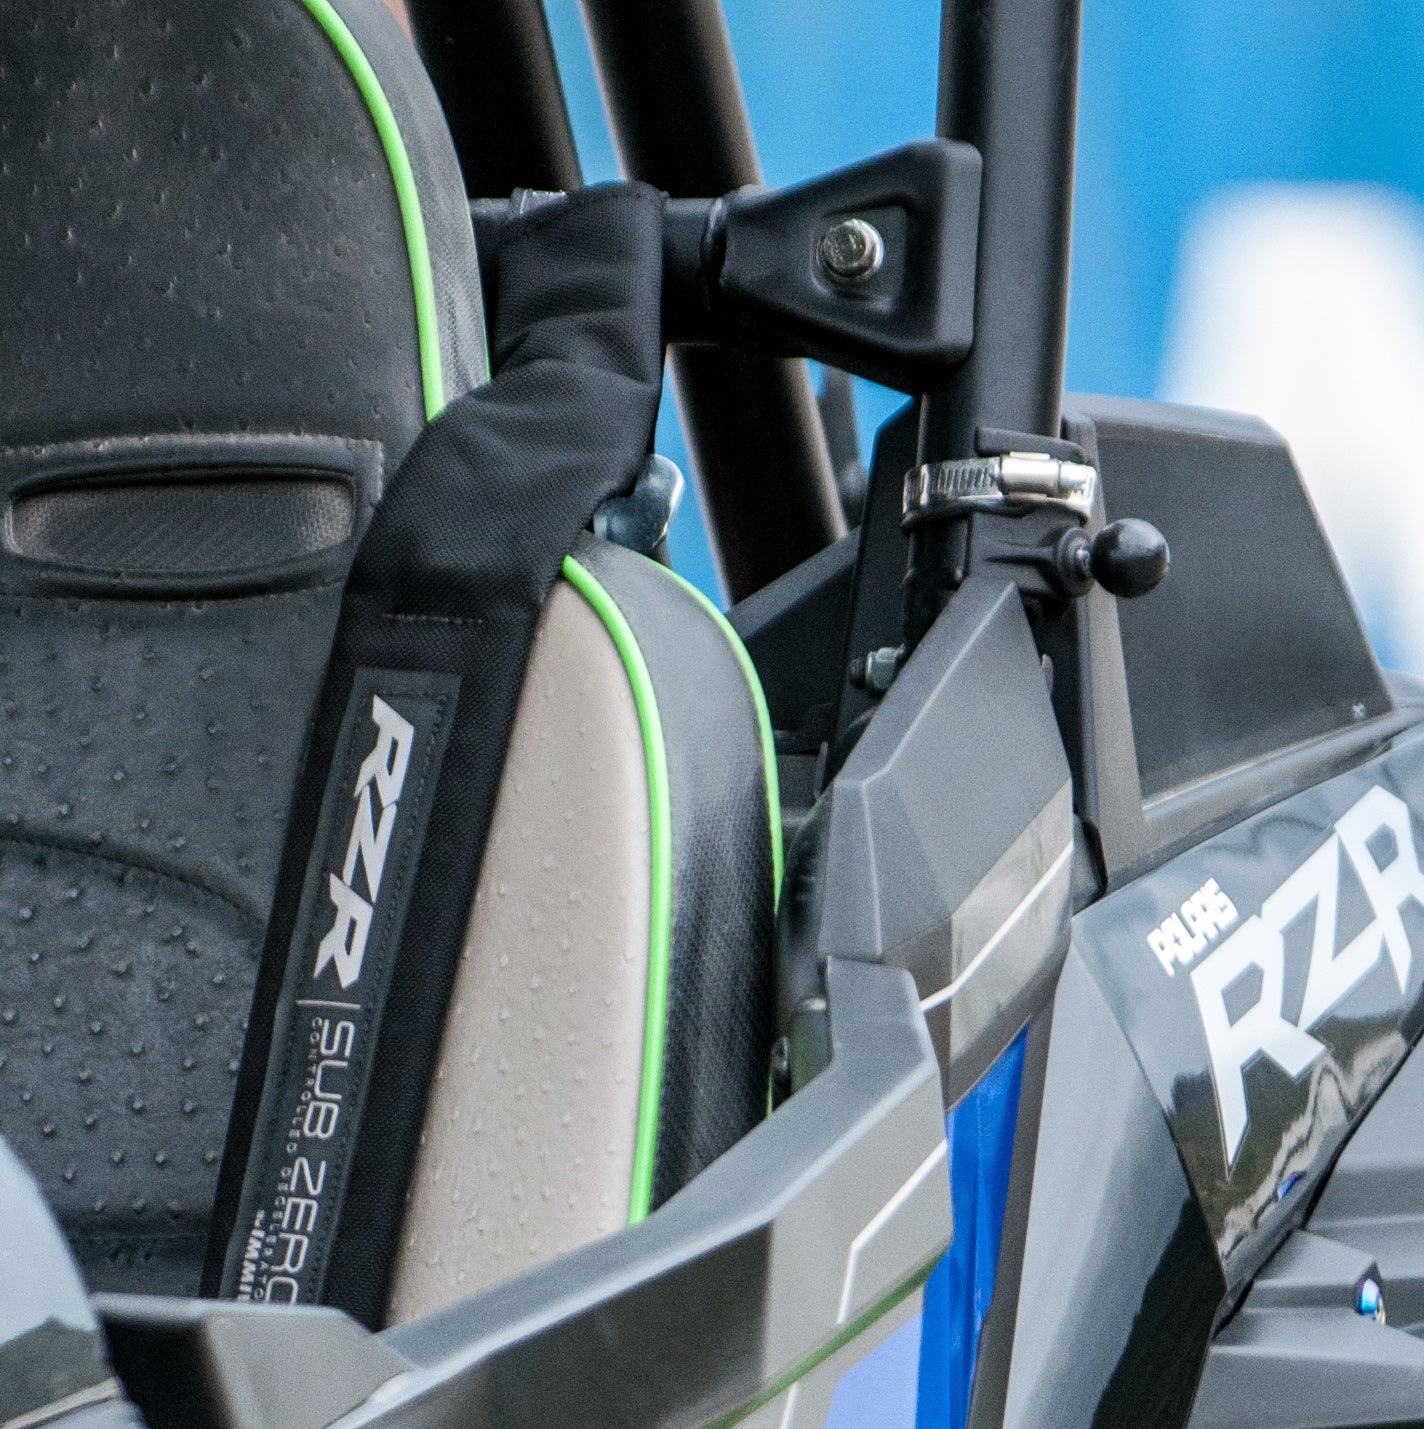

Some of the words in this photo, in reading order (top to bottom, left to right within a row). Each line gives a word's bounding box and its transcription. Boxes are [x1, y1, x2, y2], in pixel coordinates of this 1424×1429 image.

[313, 694, 414, 989] RZR
[1147, 877, 1239, 977] POLARIS
[286, 1016, 322, 1154] CONTROLLED
[303, 1019, 355, 1139] SUB
[265, 1156, 327, 1305] ZERO
